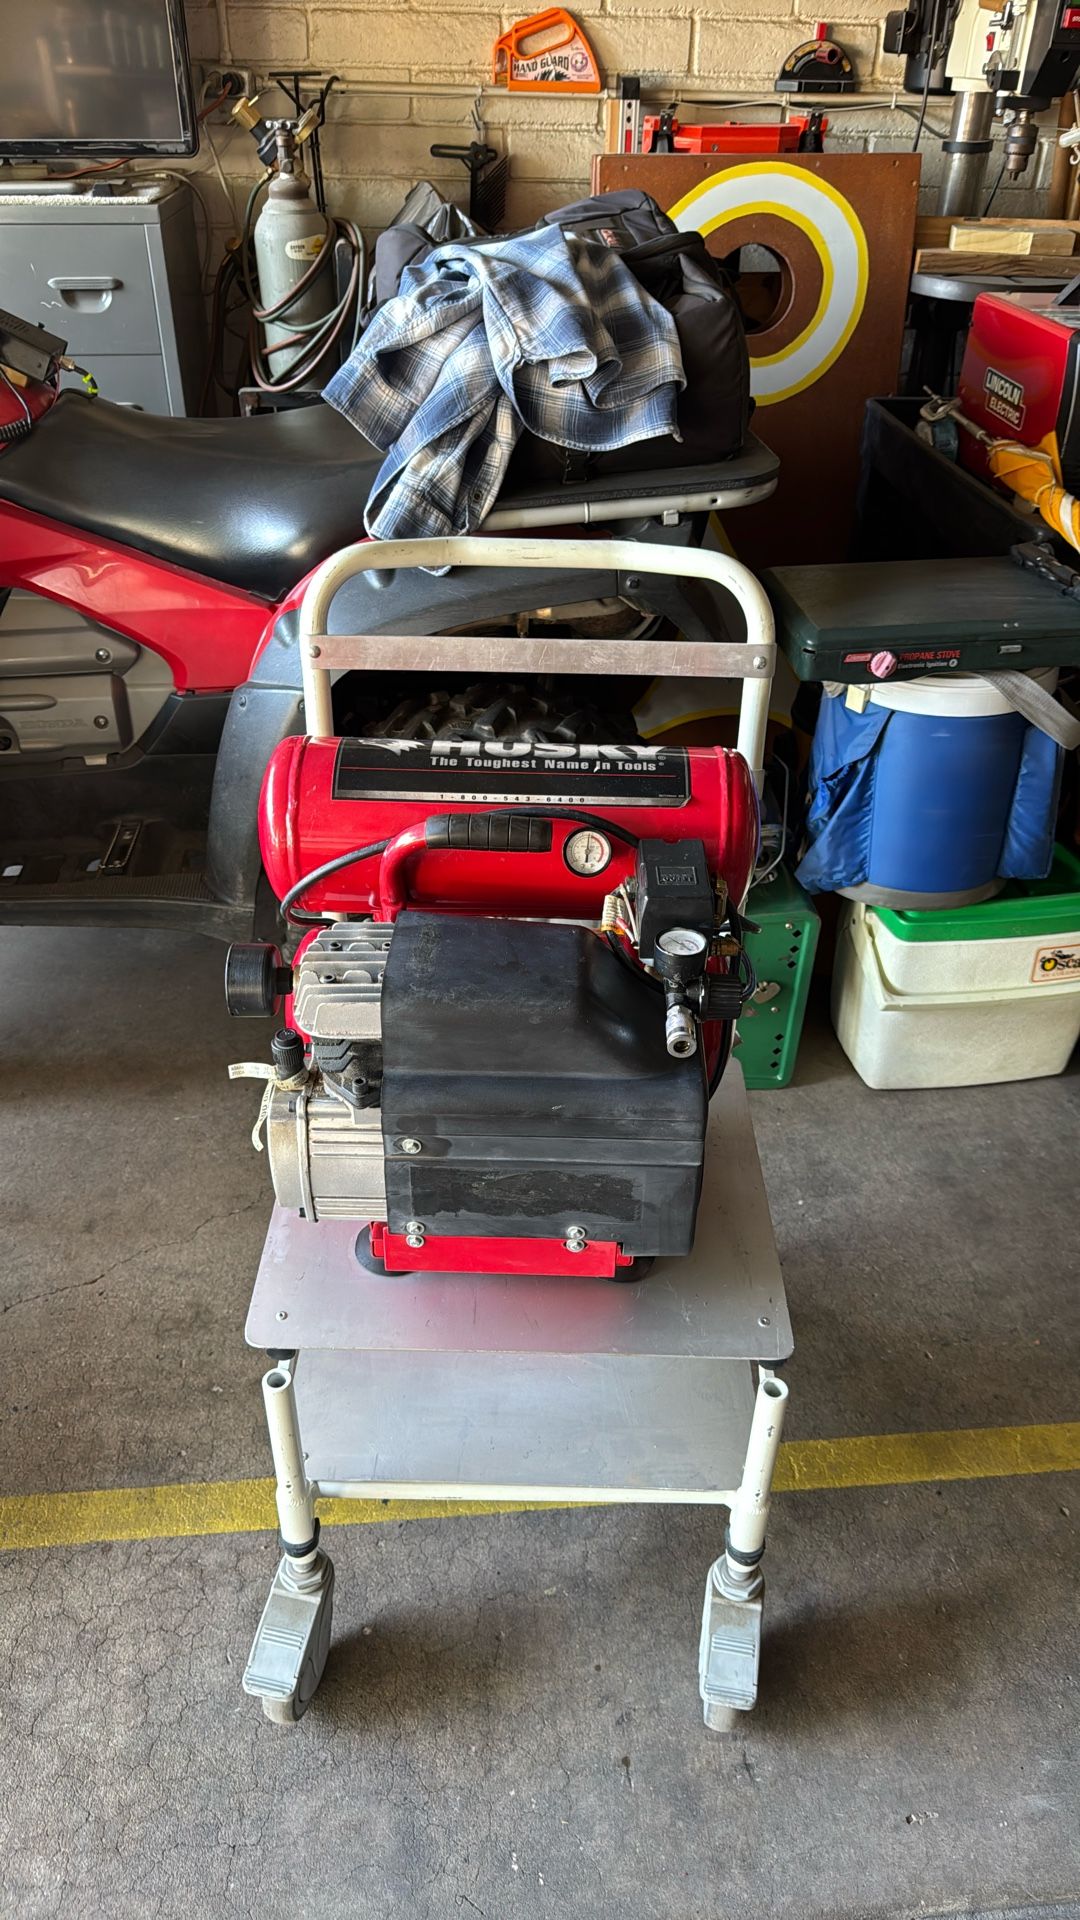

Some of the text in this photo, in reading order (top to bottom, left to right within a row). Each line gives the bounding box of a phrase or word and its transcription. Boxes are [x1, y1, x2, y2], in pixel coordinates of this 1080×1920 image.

[513, 56, 569, 73] HAND GUARD
[986, 372, 1021, 405] LINCOLN
[989, 397, 1020, 424] ELECTRIC
[900, 650, 960, 660] PROPANE STOVE
[430, 740, 666, 761] HUSKY
[430, 756, 458, 766] The
[466, 757, 537, 769] Toughest
[544, 759, 589, 770] Name
[616, 761, 657, 772] Tools
